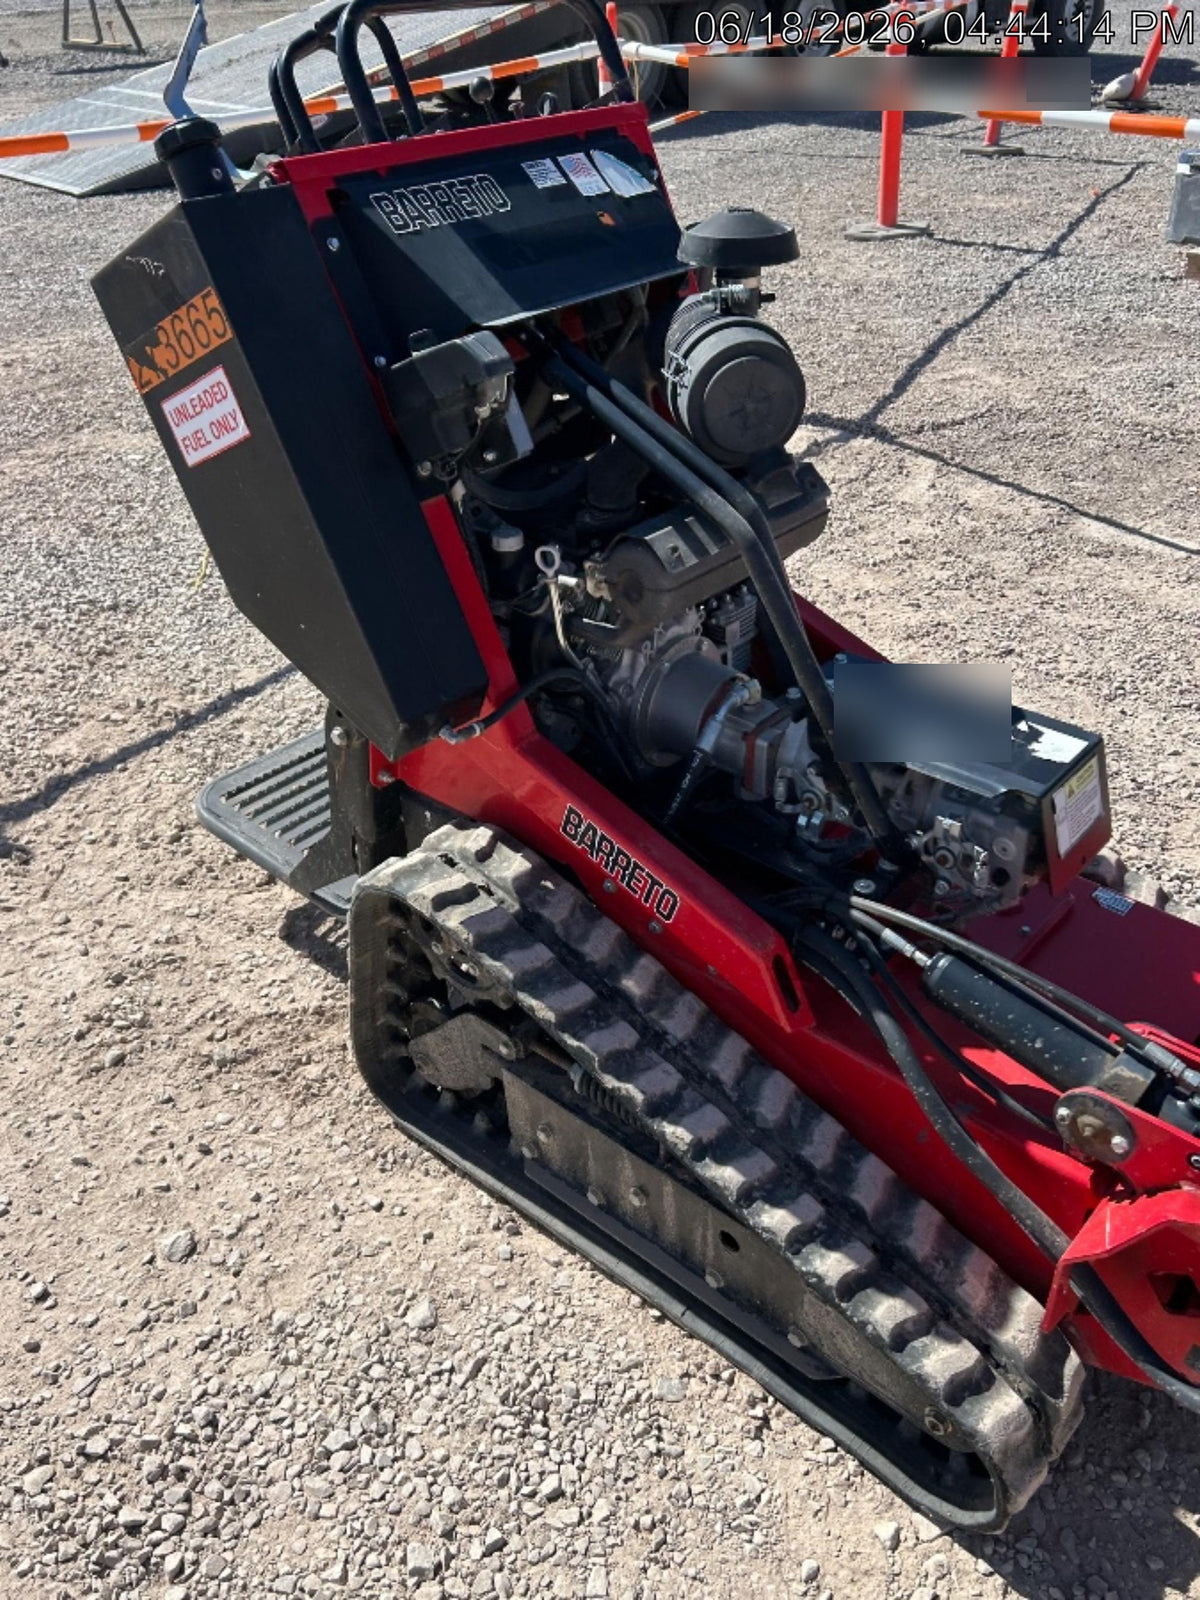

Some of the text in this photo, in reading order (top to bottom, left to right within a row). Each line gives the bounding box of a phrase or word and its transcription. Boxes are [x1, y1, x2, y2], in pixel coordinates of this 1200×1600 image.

[369, 173, 511, 234] BARRETO
[168, 380, 229, 428] UNLEADED
[180, 407, 239, 456] FUEL ONLY
[560, 803, 680, 923] BARRETO
